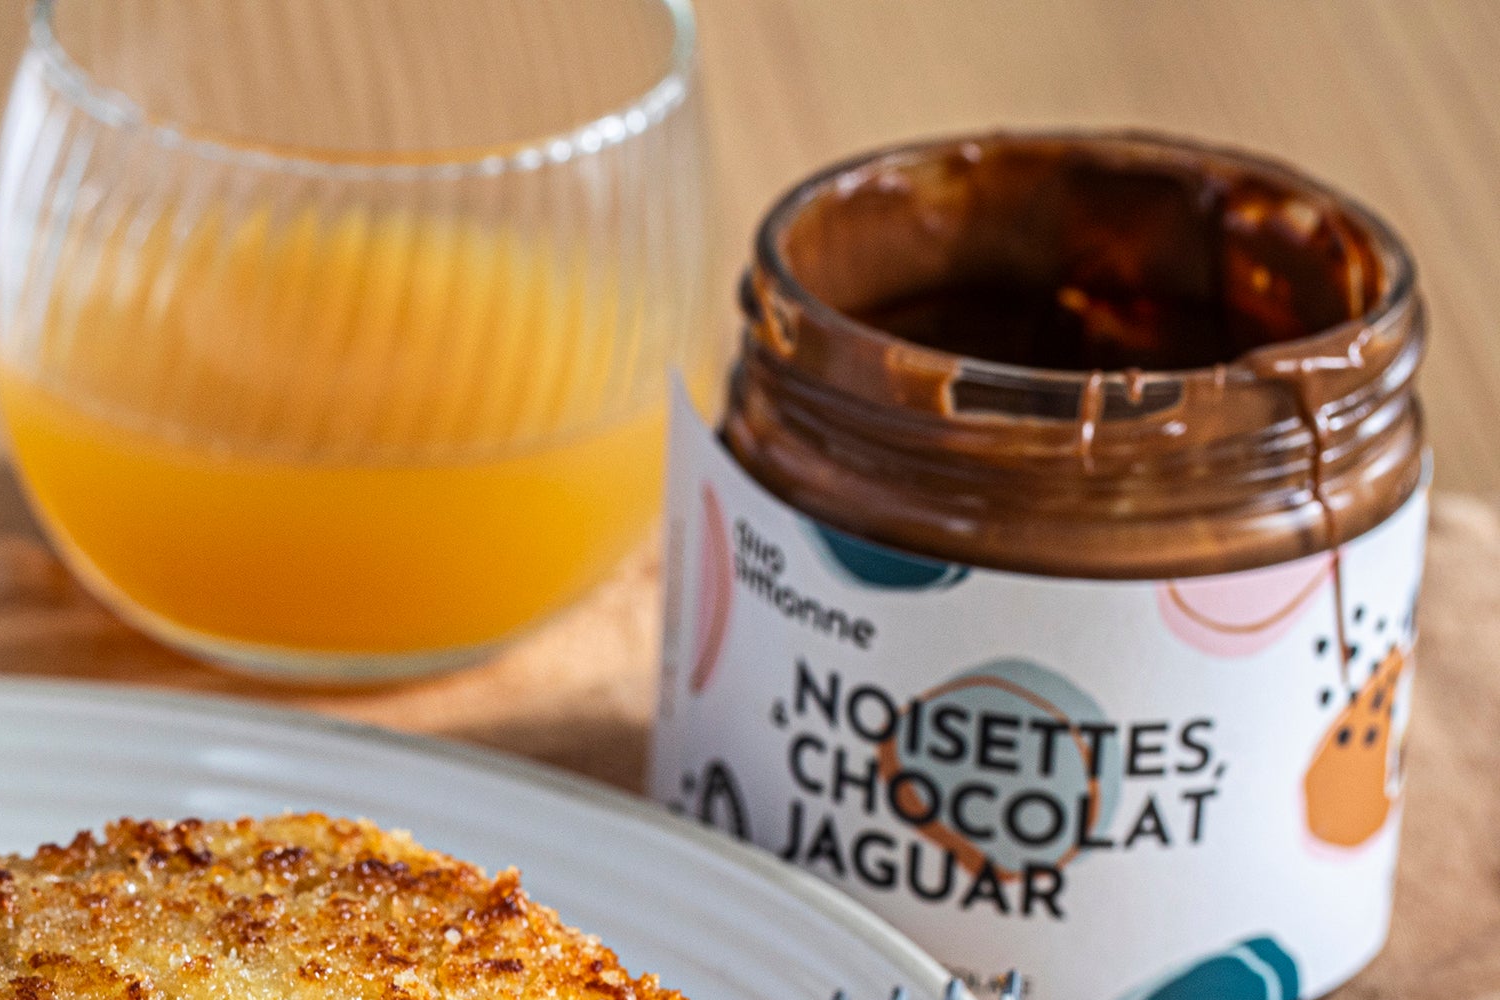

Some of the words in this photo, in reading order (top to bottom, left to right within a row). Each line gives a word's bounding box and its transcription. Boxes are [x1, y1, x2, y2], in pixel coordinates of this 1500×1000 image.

[793, 656, 1229, 780] NOISETTES,
[788, 732, 1218, 849] CHOCOLAT
[779, 800, 1068, 920] JAGUAR
